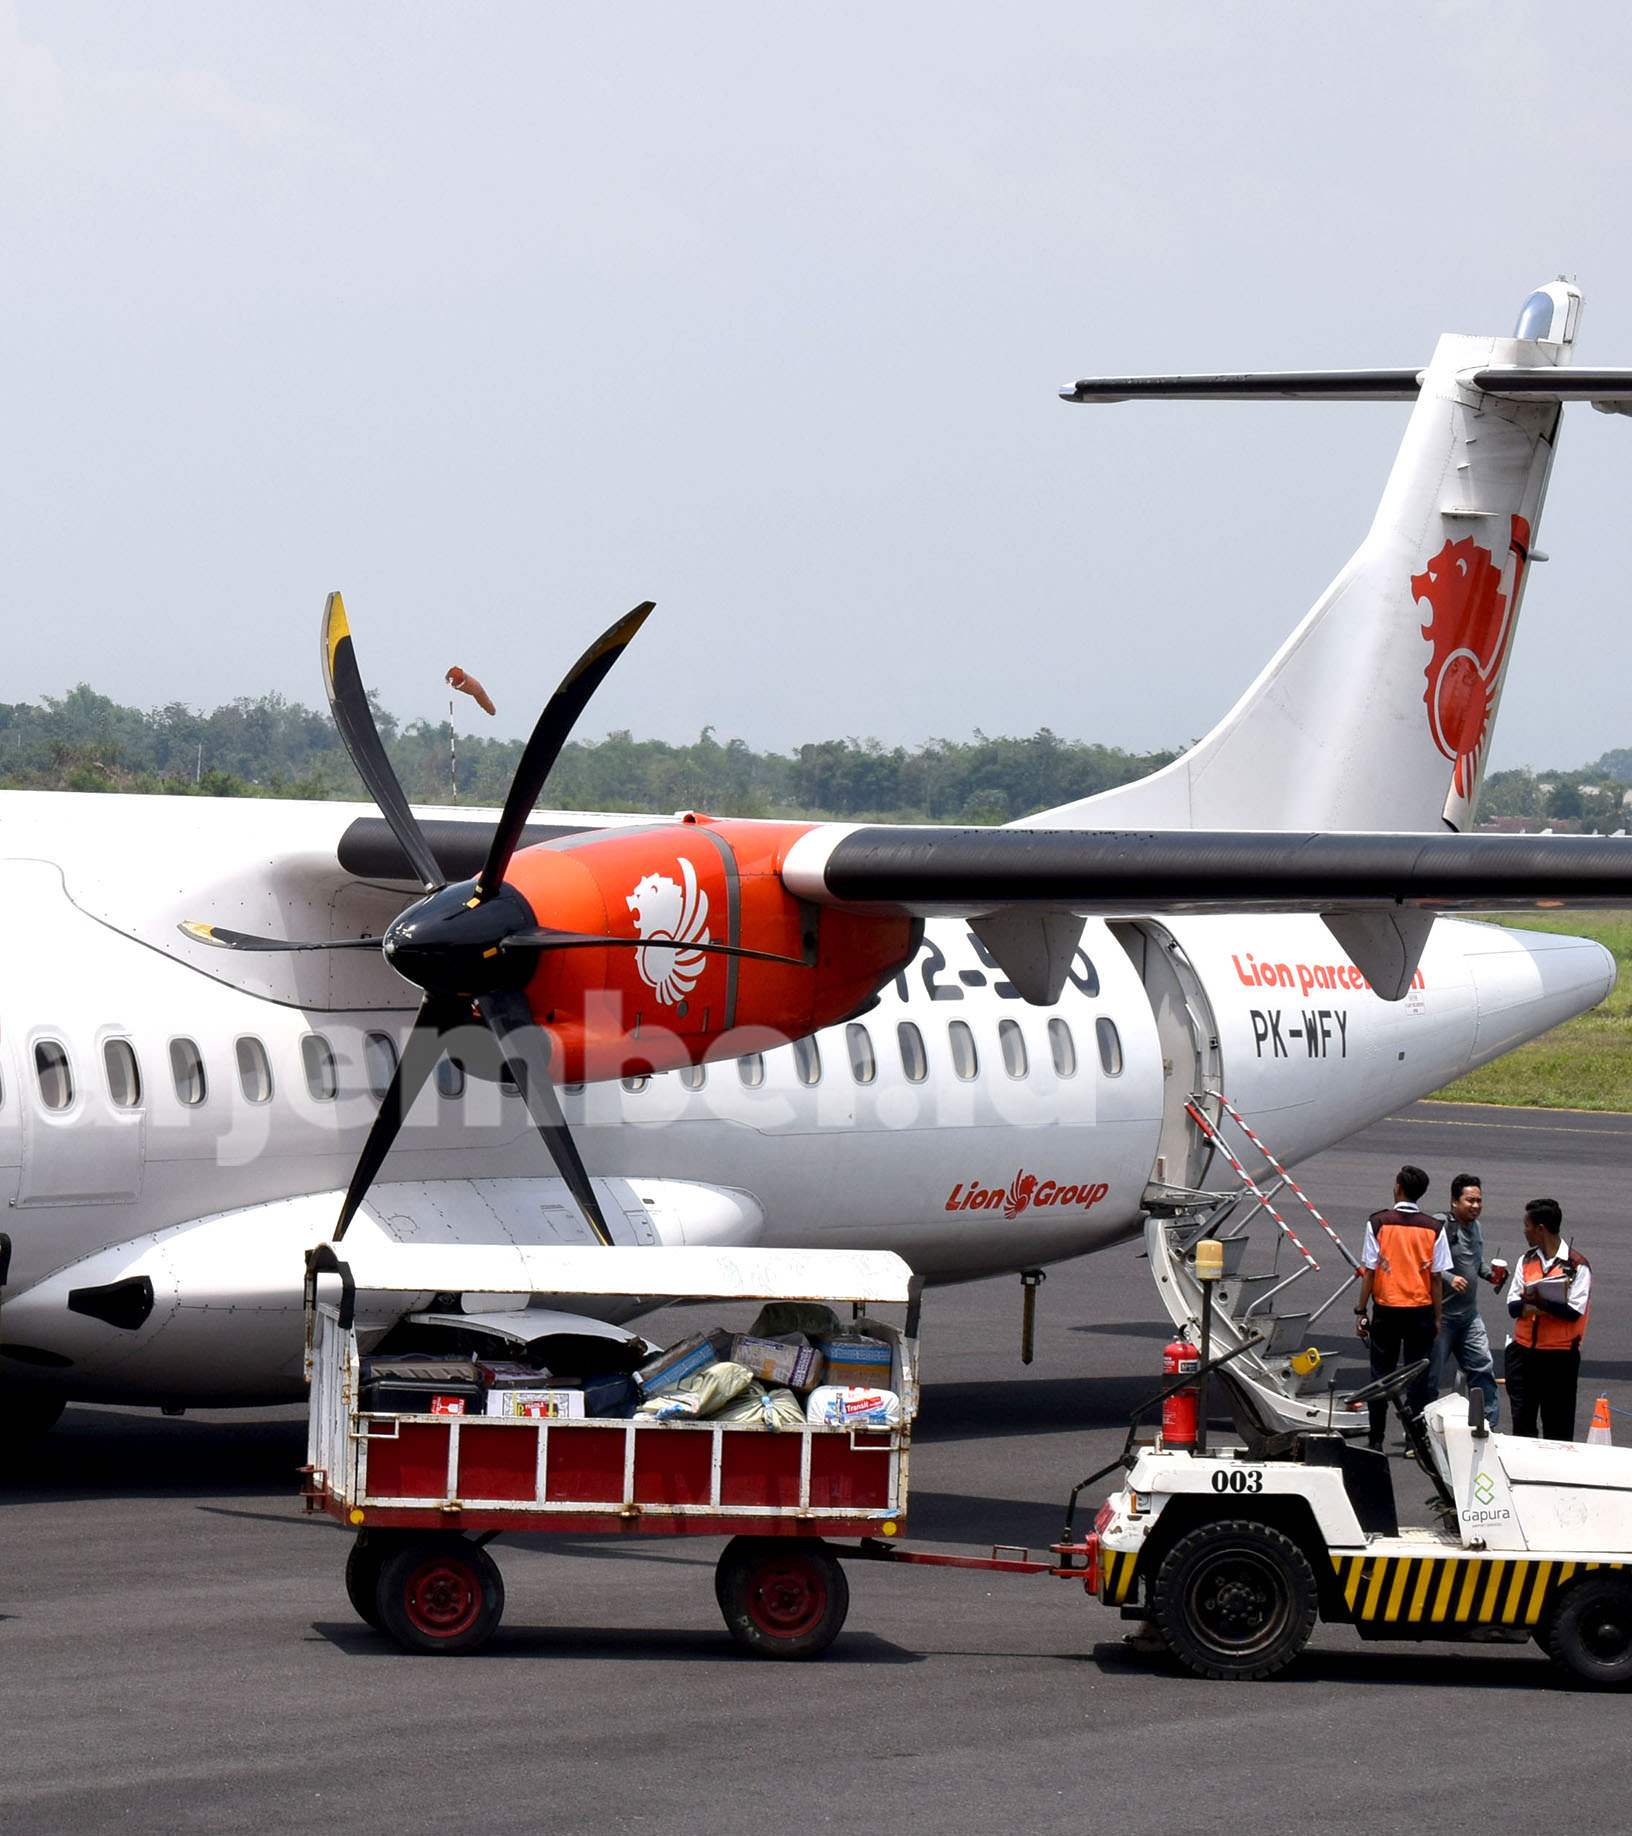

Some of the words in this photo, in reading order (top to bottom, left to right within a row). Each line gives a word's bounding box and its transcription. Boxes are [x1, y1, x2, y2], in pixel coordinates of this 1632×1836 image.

[1232, 953, 1295, 988] Lion
[1250, 1010, 1347, 1058] PK-WFY
[945, 1181, 1006, 1211] Lion
[1033, 1180, 1109, 1210] Group
[1211, 1470, 1263, 1493] 003
[1462, 1509, 1511, 1523] Gapura
